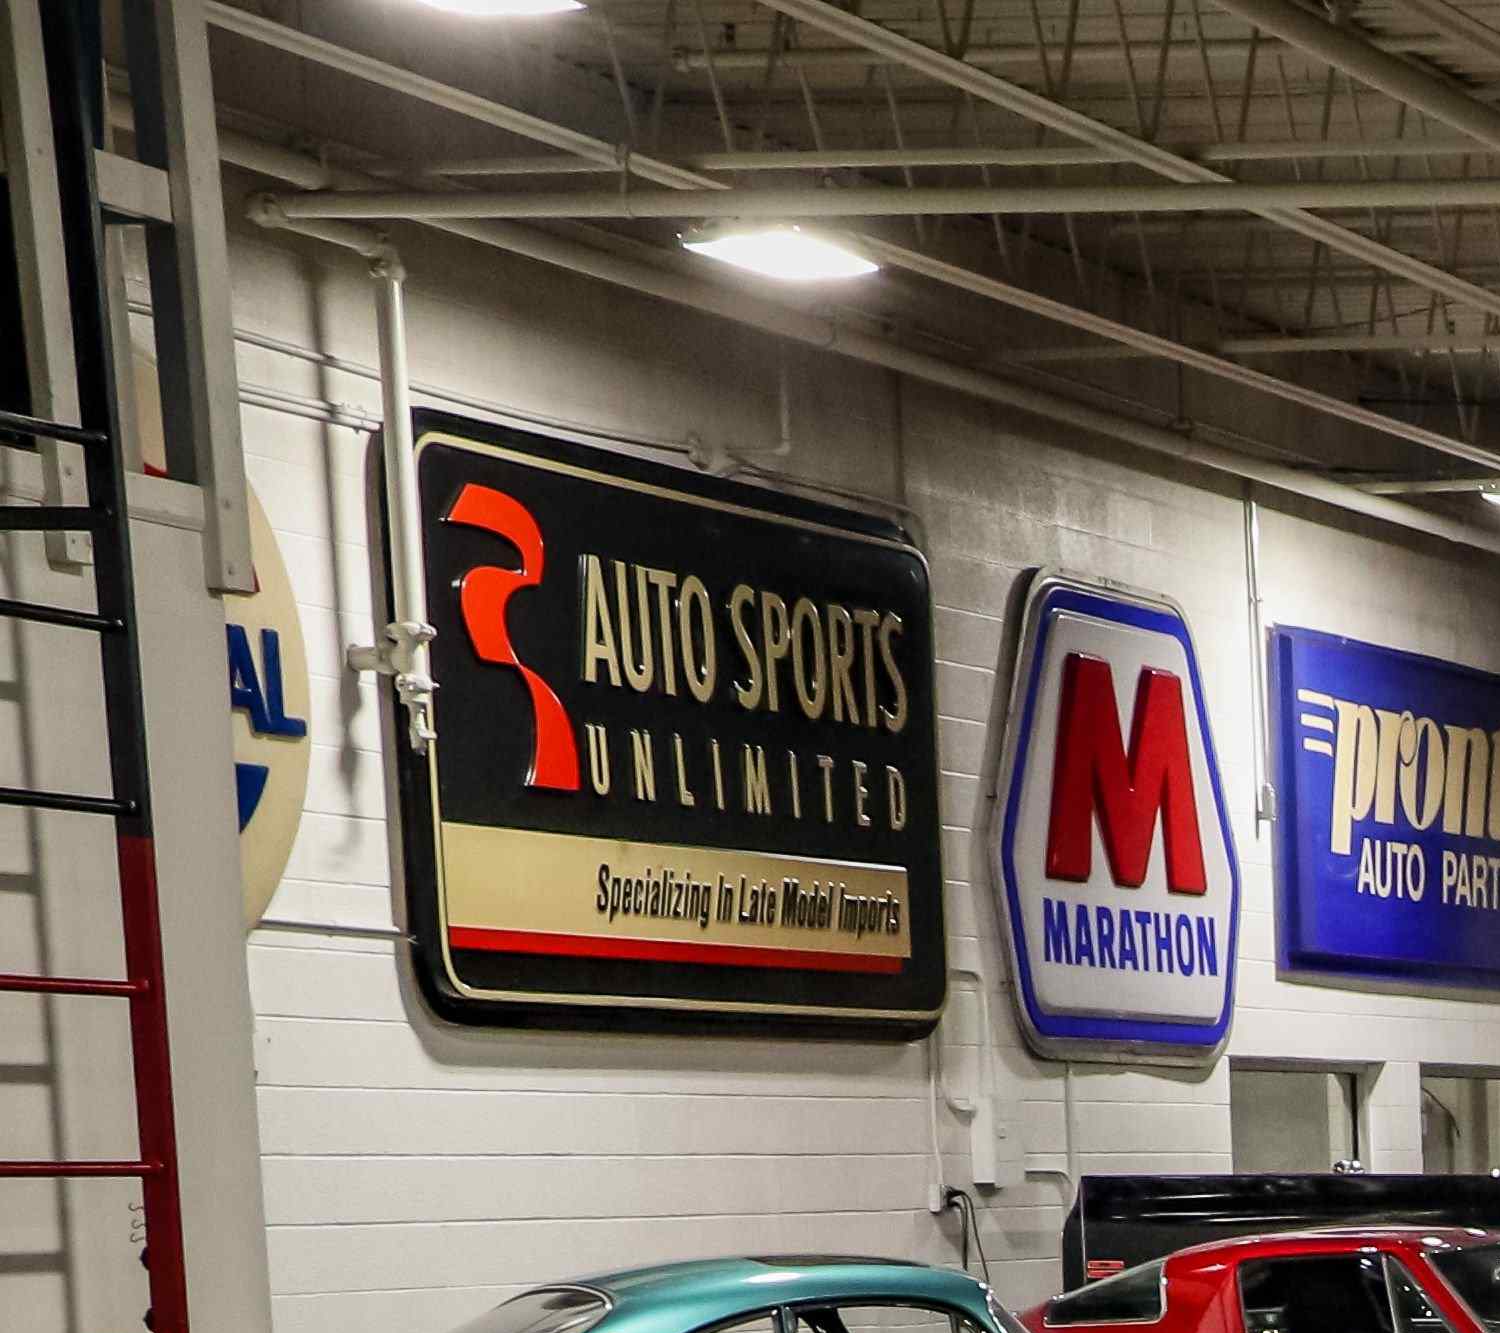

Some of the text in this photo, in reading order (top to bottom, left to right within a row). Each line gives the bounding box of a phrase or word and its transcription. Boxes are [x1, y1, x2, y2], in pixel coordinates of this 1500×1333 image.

[579, 553, 908, 734] AUTO SPORTS
[585, 721, 907, 832] UNLIMITED
[1045, 651, 1208, 897] M
[596, 863, 900, 940] Specializing In Late Model Imports
[1357, 837, 1426, 903] AUTO
[1043, 897, 1219, 978] MARATHON
